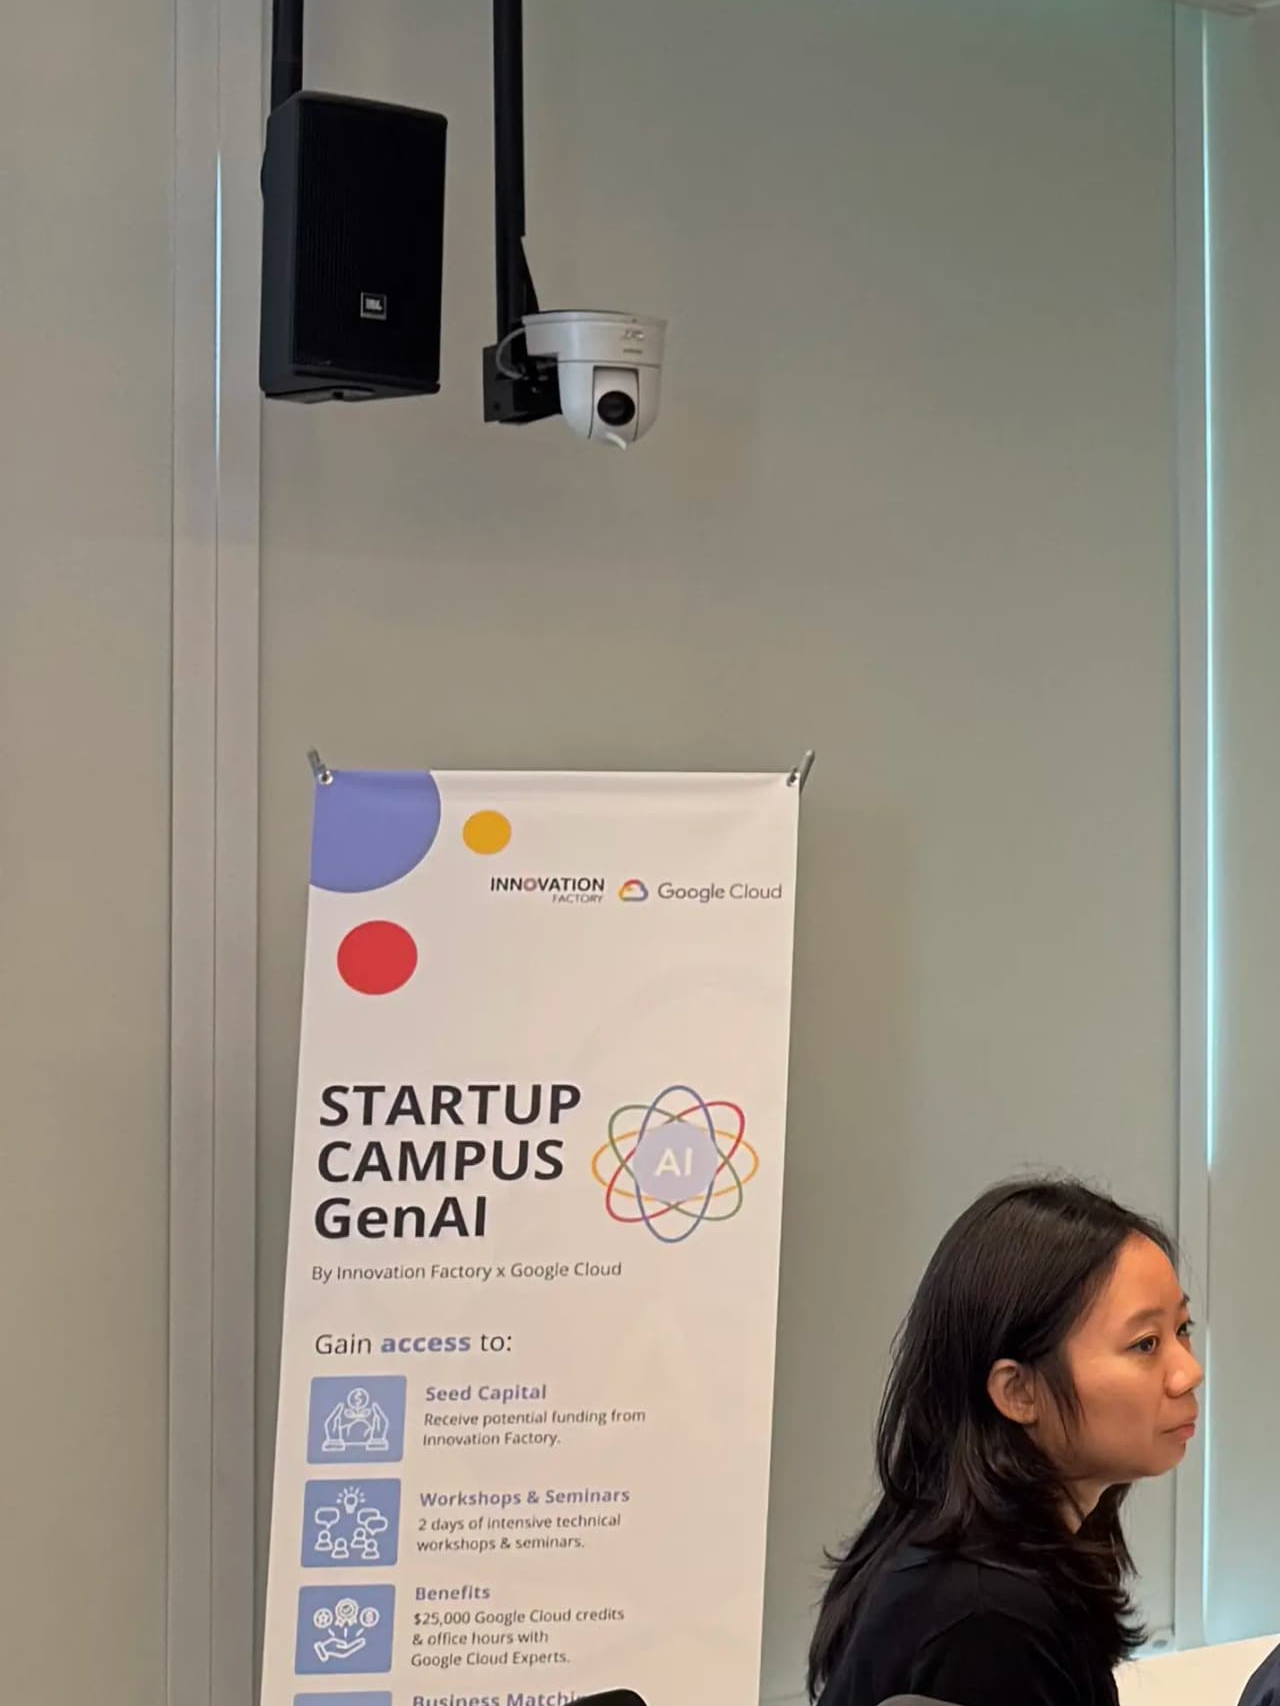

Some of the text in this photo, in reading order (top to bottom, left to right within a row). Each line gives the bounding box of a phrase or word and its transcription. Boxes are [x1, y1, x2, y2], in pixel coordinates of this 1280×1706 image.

[490, 877, 605, 893] INNOVATION
[658, 882, 782, 902] Google Cloud
[552, 894, 603, 903] FACTORY
[320, 1084, 581, 1127] STARTUP
[318, 1139, 564, 1182] CAMPUS
[654, 1151, 693, 1176] AI
[315, 1196, 486, 1239] GenAI
[312, 1261, 622, 1282] By Innovation Factory x Google Cloud
[315, 1332, 512, 1355] Gain access to:
[426, 1384, 547, 1404] Seed Capital
[424, 1409, 645, 1428] Receive potential funding from
[424, 1431, 560, 1447] Innovation Factory.
[420, 1489, 630, 1508] Workshops & Seminars
[418, 1514, 620, 1533] 2 days of intensive technical
[417, 1537, 585, 1552] workshops & seminars.
[416, 1585, 490, 1600] Benefits
[414, 1609, 624, 1626] $25,000 Google Cloud credits
[413, 1630, 549, 1645] & office hours with
[411, 1651, 570, 1669] Google Cloud Experts.
